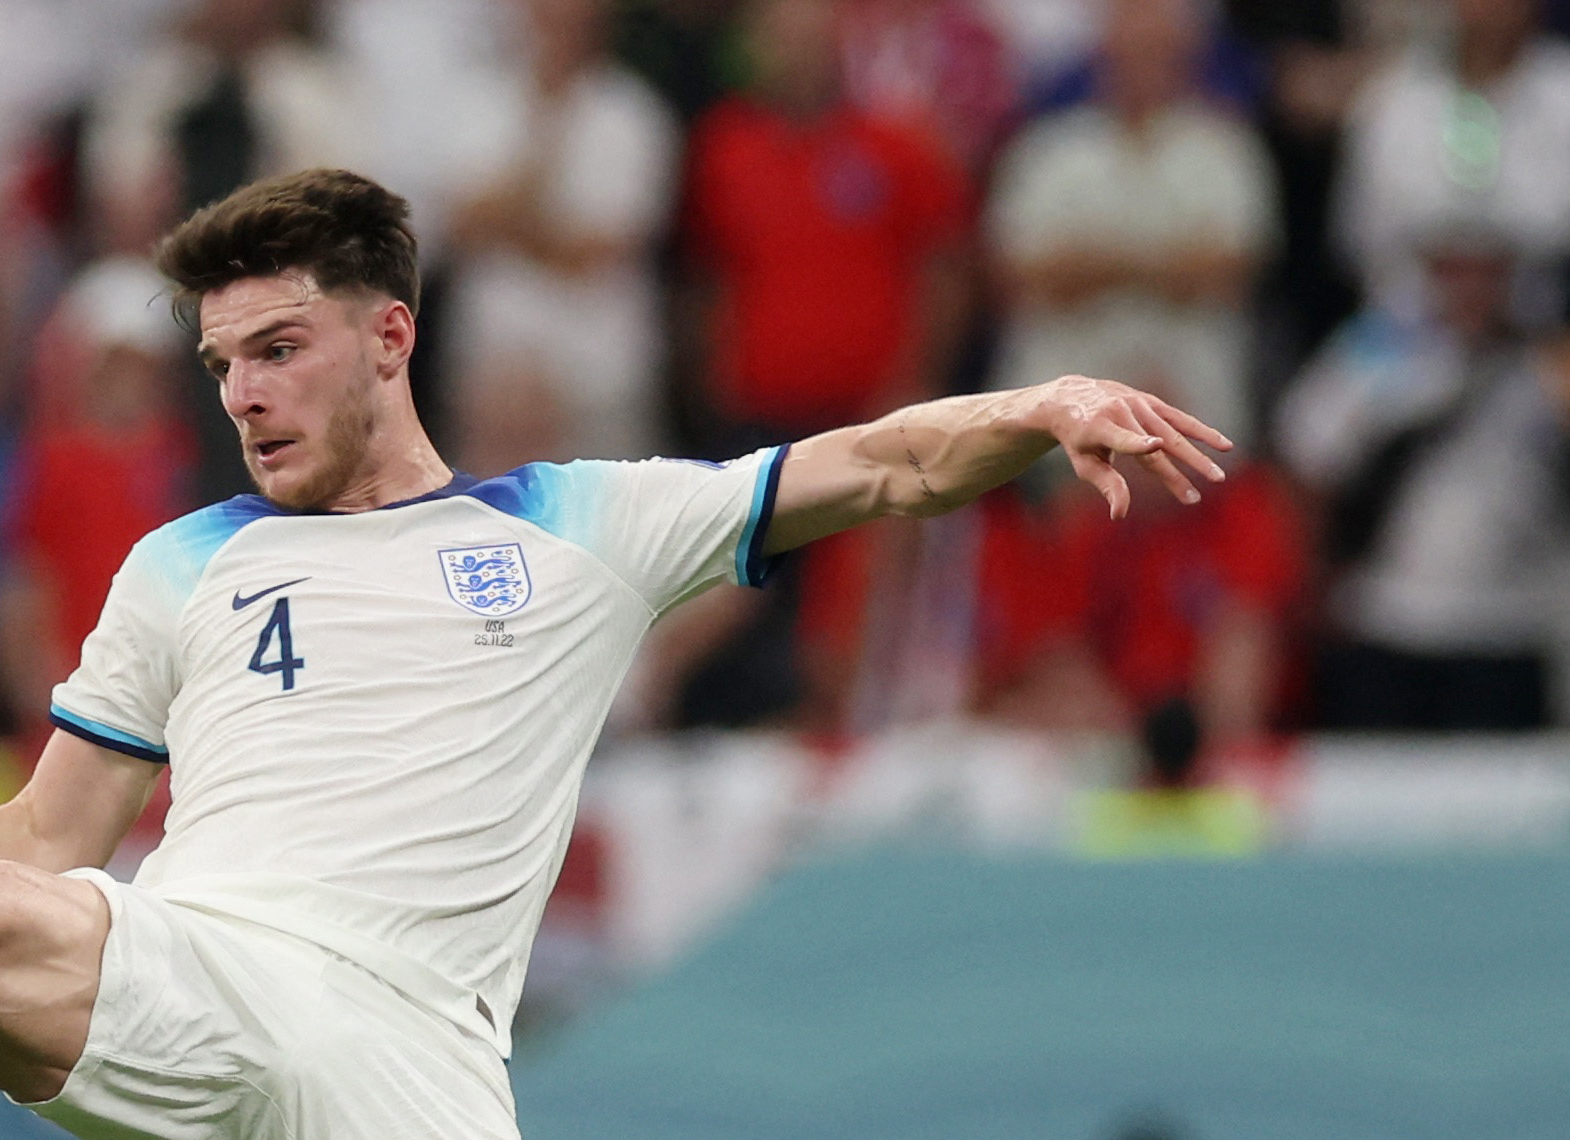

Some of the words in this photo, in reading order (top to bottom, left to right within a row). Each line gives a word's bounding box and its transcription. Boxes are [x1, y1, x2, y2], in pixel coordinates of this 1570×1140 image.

[484, 619, 505, 633] USA
[248, 596, 304, 691] 4
[474, 633, 515, 648] 25.11.22
